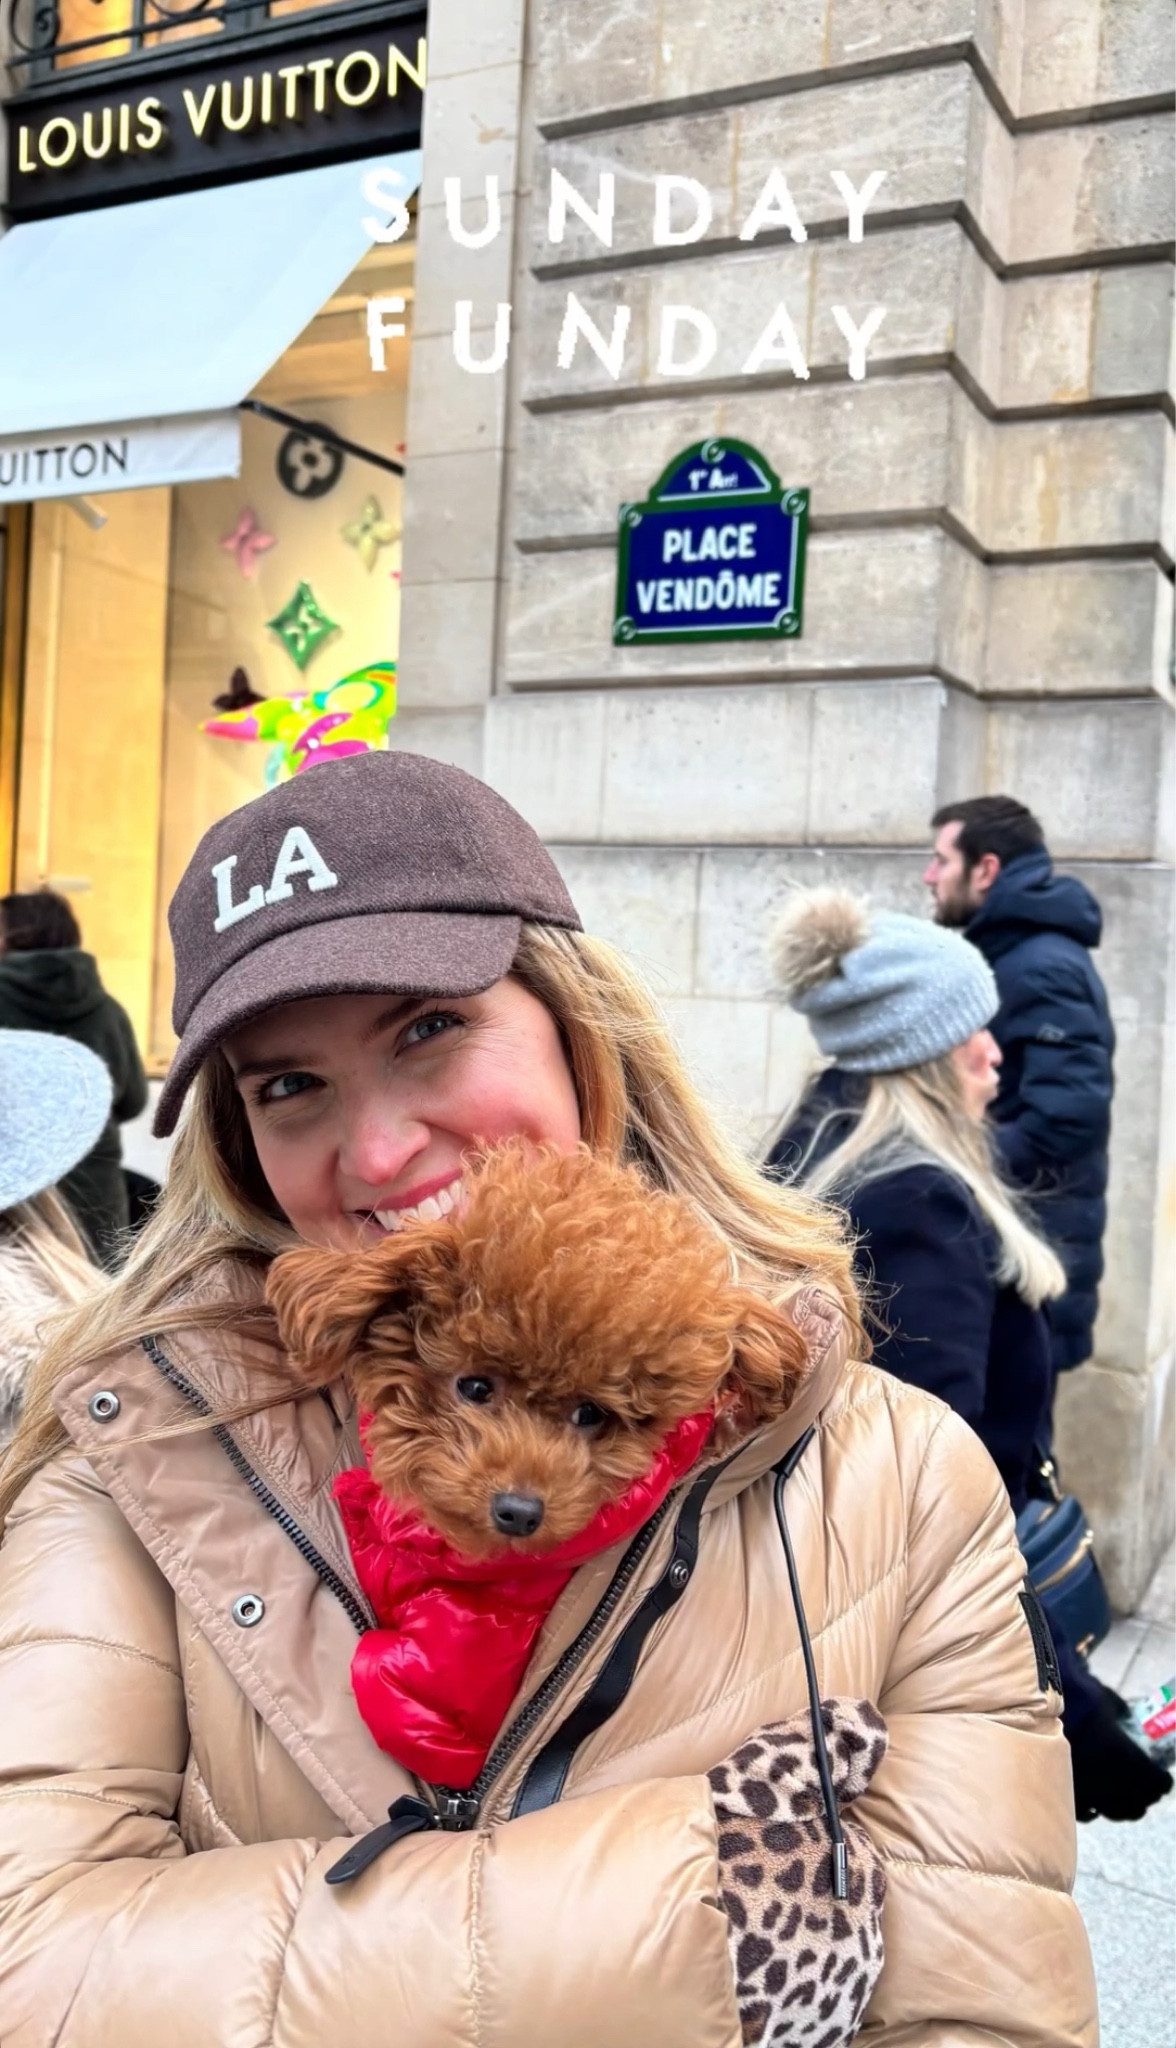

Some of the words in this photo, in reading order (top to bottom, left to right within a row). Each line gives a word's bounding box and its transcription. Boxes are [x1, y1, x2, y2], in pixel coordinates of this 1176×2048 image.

[18, 96, 162, 172] LOUIS
[182, 36, 427, 137] VUITTON
[662, 522, 757, 564] PLACE
[636, 569, 782, 614] VENDÔME
[211, 826, 338, 933] LA
